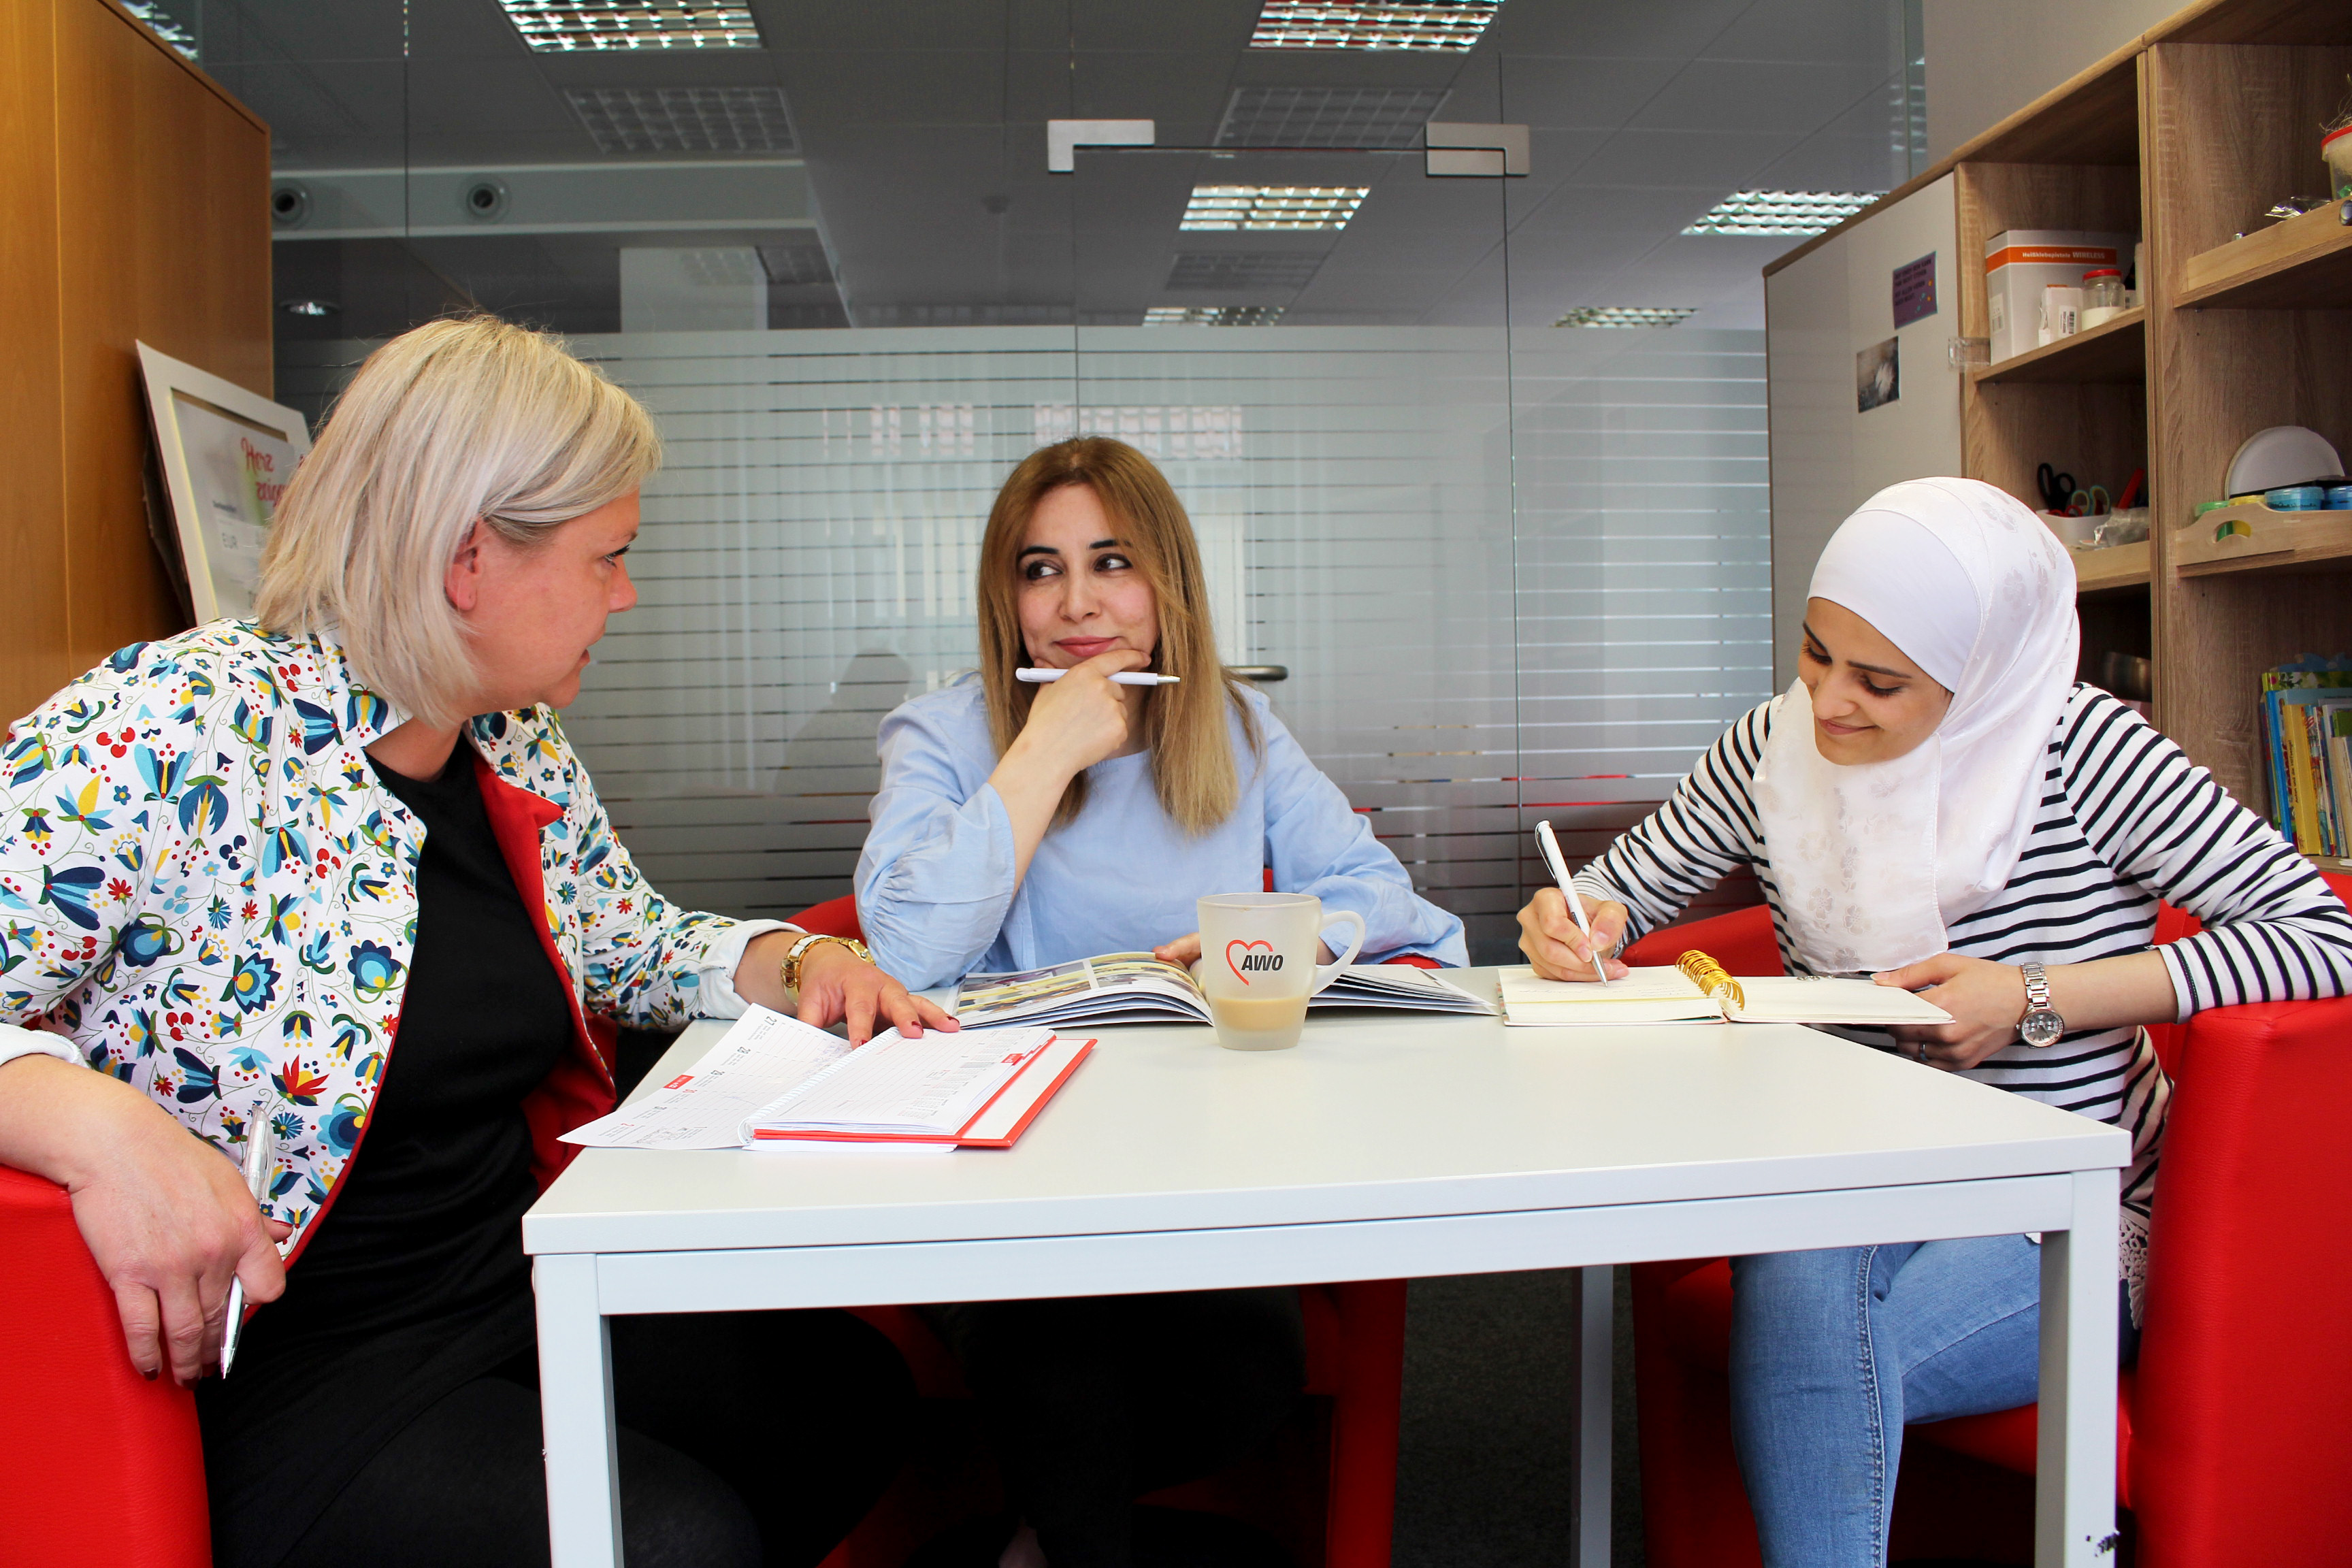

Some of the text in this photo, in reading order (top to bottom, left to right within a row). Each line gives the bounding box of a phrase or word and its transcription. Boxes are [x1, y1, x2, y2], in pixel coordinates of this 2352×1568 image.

[1241, 955, 1284, 971] AWO
[764, 1015, 777, 1026] 27
[737, 1046, 751, 1054] 28
